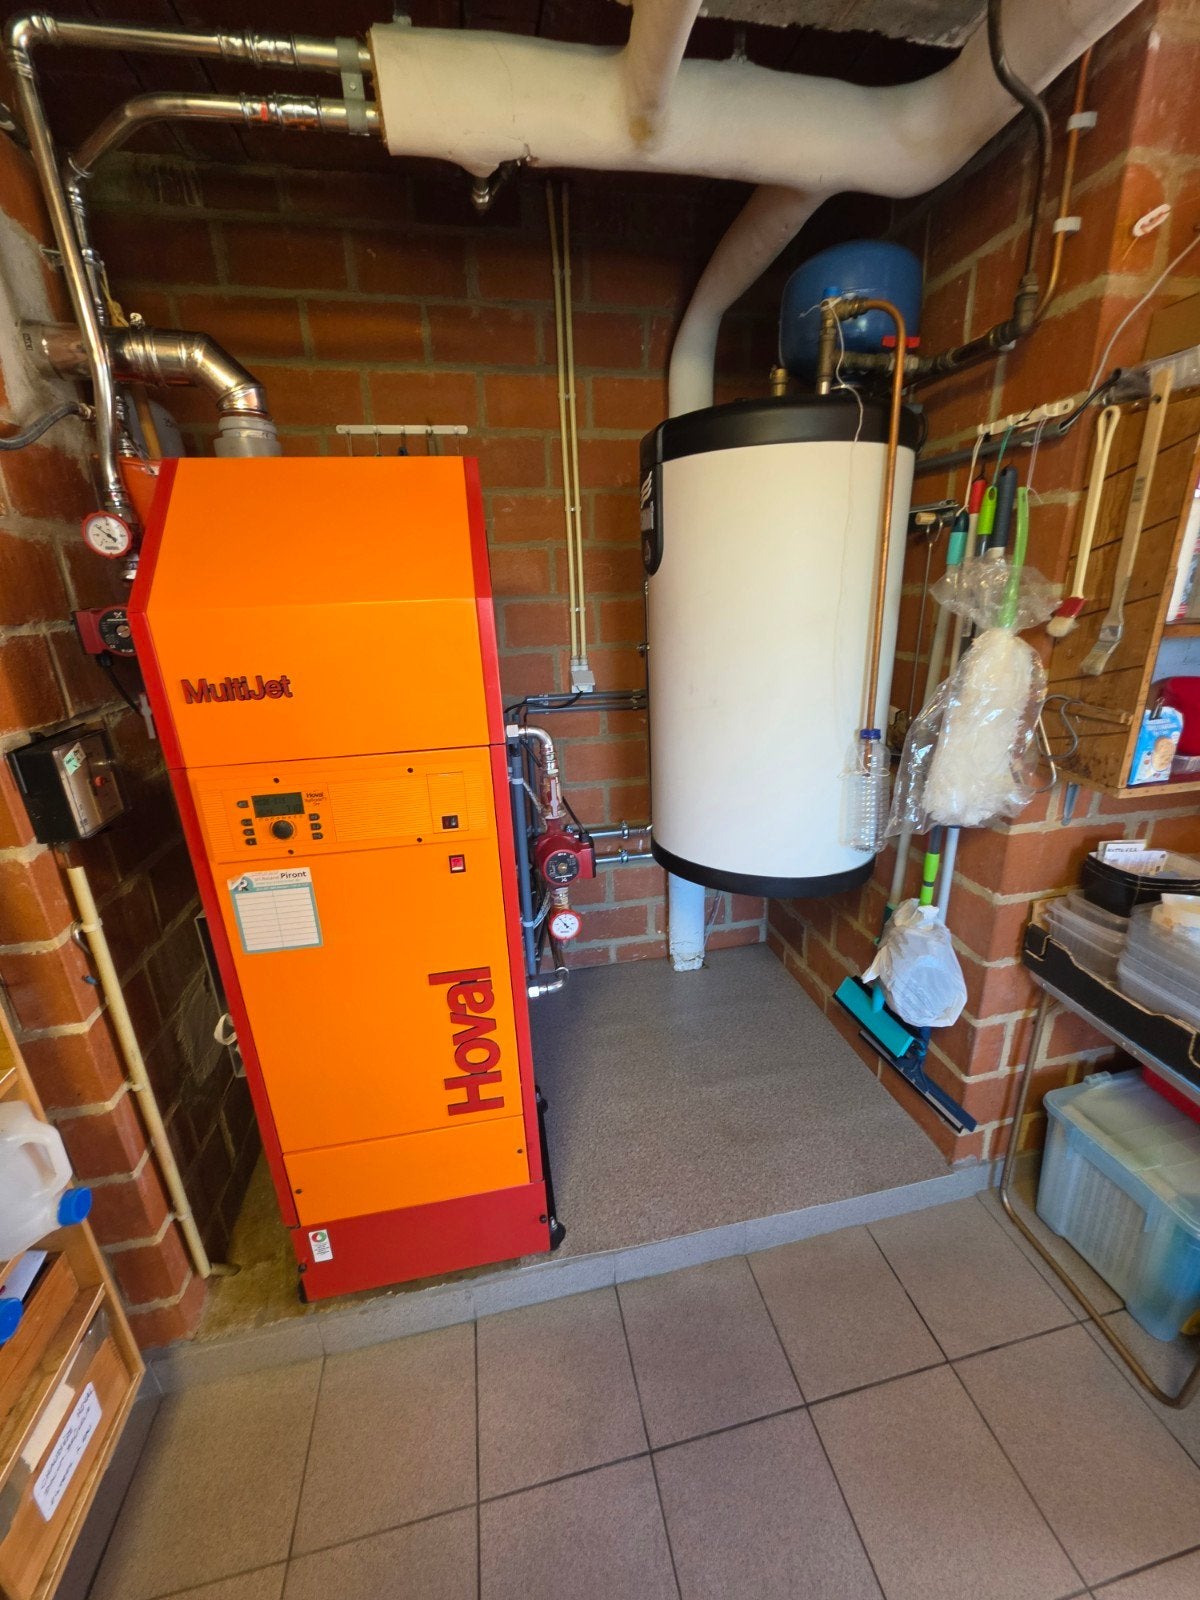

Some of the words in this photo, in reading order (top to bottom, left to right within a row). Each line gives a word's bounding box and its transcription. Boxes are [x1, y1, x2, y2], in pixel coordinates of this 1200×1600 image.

[181, 675, 293, 704] MultiJet
[280, 871, 307, 880] Piront
[428, 966, 504, 1116] Hoval
